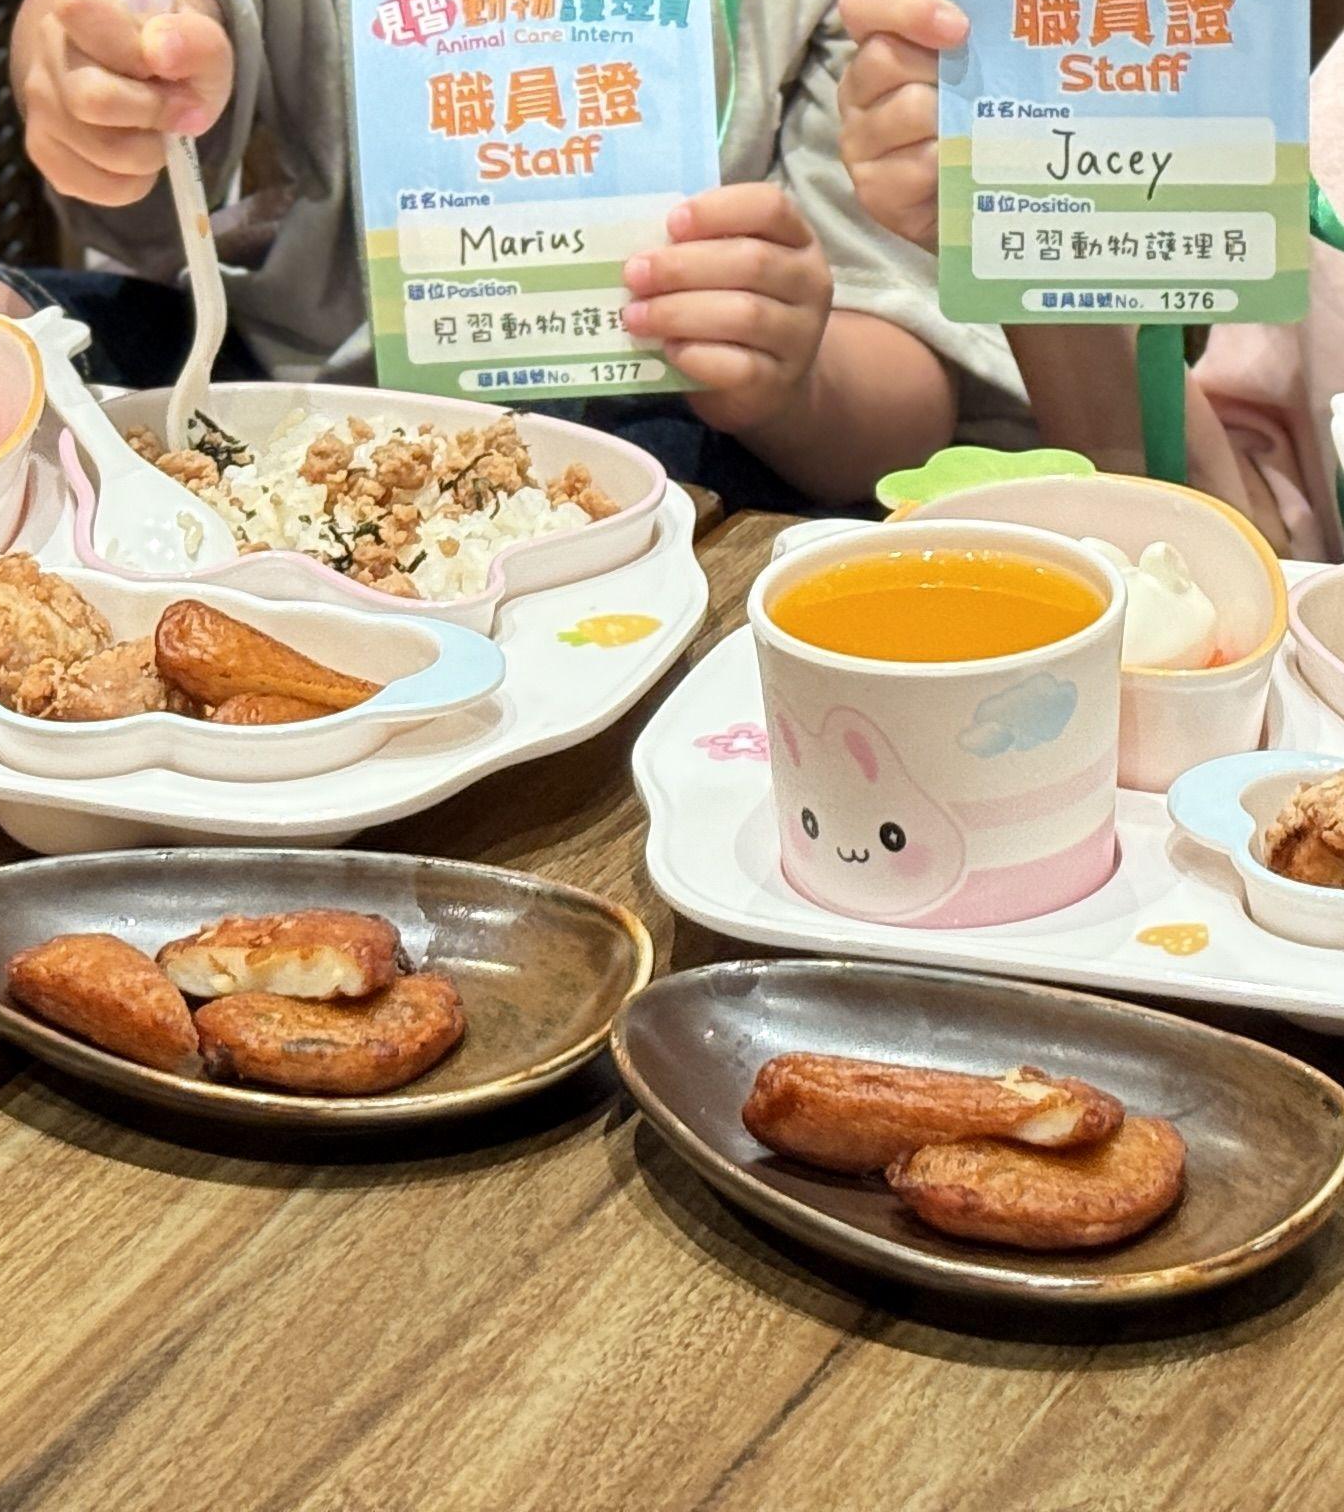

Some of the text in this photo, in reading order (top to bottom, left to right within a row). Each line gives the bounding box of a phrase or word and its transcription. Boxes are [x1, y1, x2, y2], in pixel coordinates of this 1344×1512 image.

[436, 26, 634, 56] Animal Care Intern
[1059, 52, 1192, 92] Staff
[427, 61, 644, 138] 職員證
[477, 134, 604, 180] Staff
[1046, 128, 1173, 201] Jacey
[459, 225, 586, 266] Marius
[1000, 228, 1248, 263] 見習動物護理員
[1159, 291, 1215, 311] 1376
[589, 362, 643, 383] 1377
